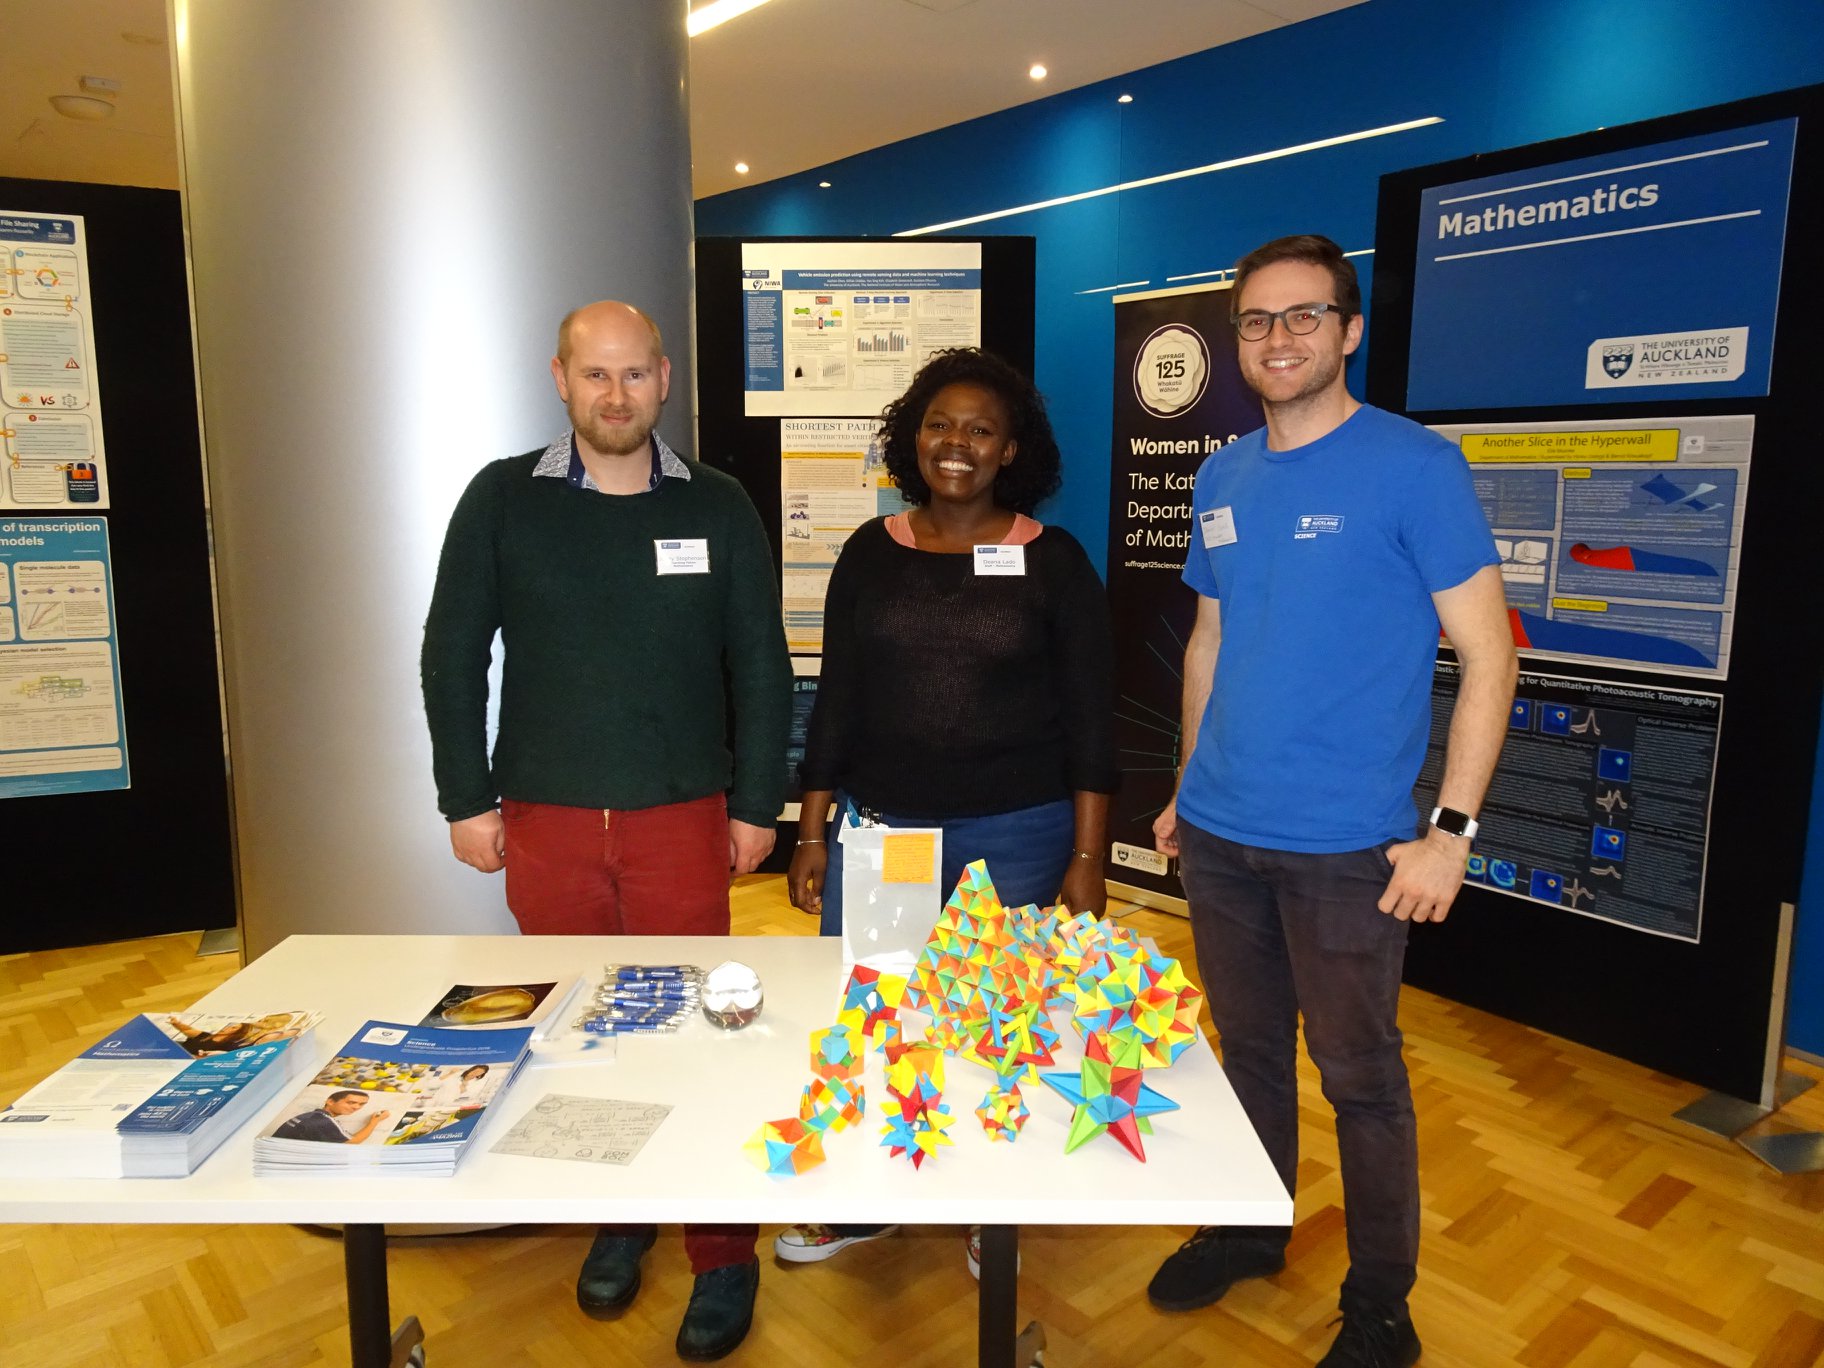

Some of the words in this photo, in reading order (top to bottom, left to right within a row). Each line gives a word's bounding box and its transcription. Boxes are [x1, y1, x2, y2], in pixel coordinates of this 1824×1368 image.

[1437, 183, 1659, 239] Mathematics
[14, 220, 40, 230] Sharing
[1641, 342, 1659, 350] THE
[1661, 337, 1717, 349] UNIVERSITY
[1717, 335, 1731, 344] OF
[1640, 345, 1730, 363] AUCKLAND
[1156, 360, 1185, 379] 125
[1670, 368, 1728, 377] ZEALAND
[785, 422, 843, 431] SHORTEST
[847, 422, 876, 431] PATH
[1131, 437, 1200, 455] Women
[1204, 434, 1222, 454] in
[1482, 436, 1526, 448] Another
[1528, 436, 1553, 448] Slice
[1555, 436, 1566, 447] in
[1569, 436, 1588, 447] the
[1591, 434, 1652, 449] Hyperwall
[1128, 472, 1160, 490] The
[2, 522, 16, 532] of
[18, 522, 101, 534] transcription
[1125, 528, 1144, 546] of
[1526, 676, 1538, 685] for
[1540, 678, 1591, 692] Quantitative
[1592, 684, 1656, 700] Photoacoustic
[1657, 692, 1718, 709] Tomography
[1637, 716, 1661, 726] Optical
